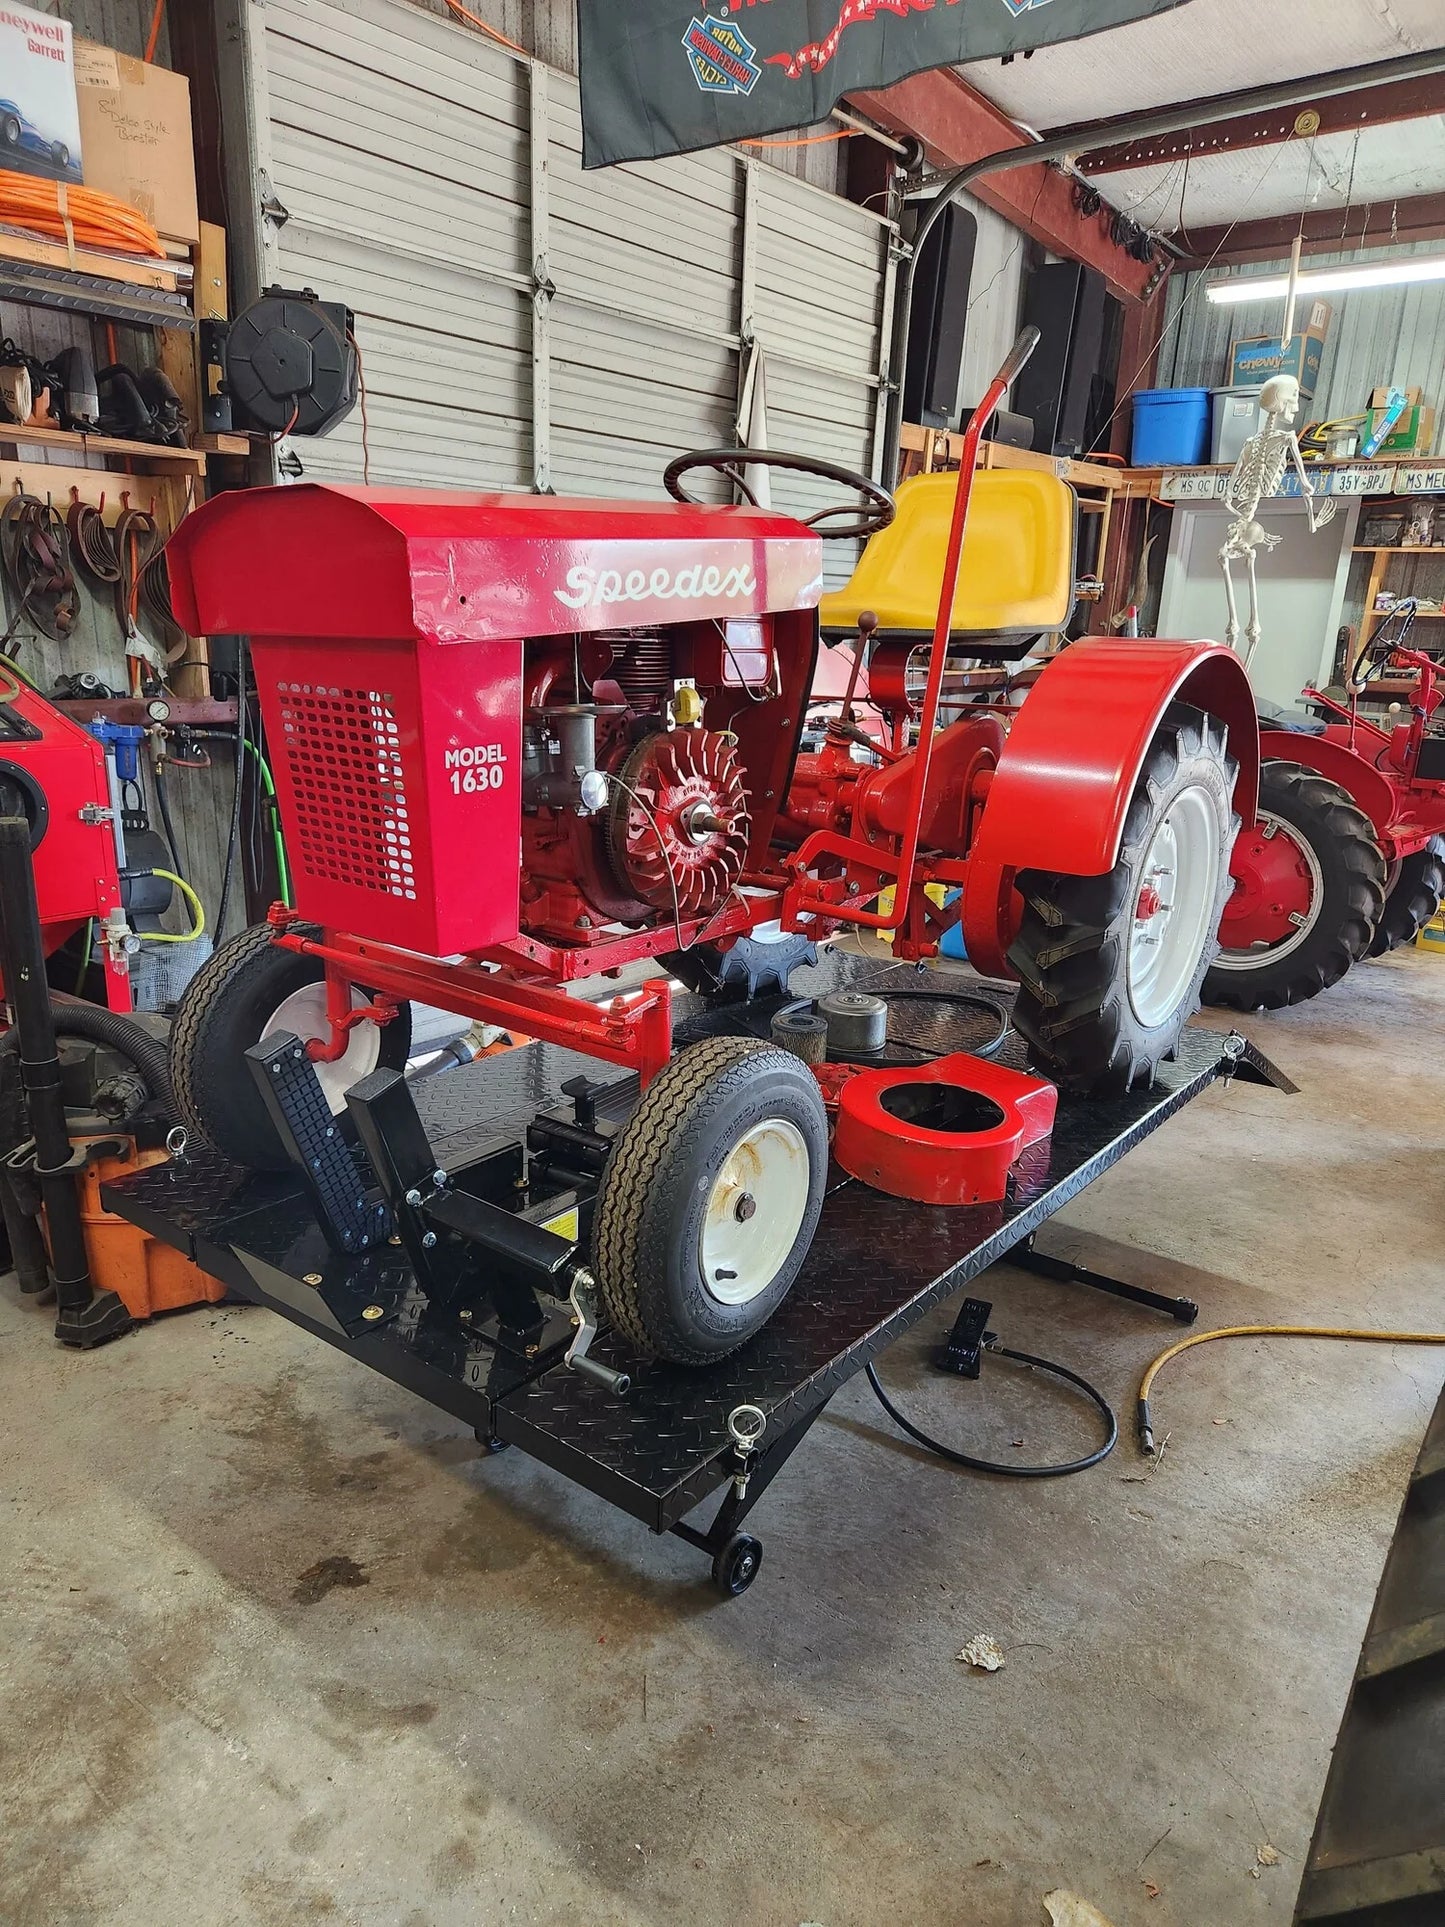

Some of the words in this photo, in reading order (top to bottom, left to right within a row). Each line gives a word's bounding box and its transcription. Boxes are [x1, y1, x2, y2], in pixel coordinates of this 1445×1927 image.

[27, 38, 66, 63] Garrett
[1405, 473, 1422, 489] MS
[553, 564, 757, 609] Speedex
[444, 743, 507, 769] MODEL
[450, 764, 503, 795] 1630
